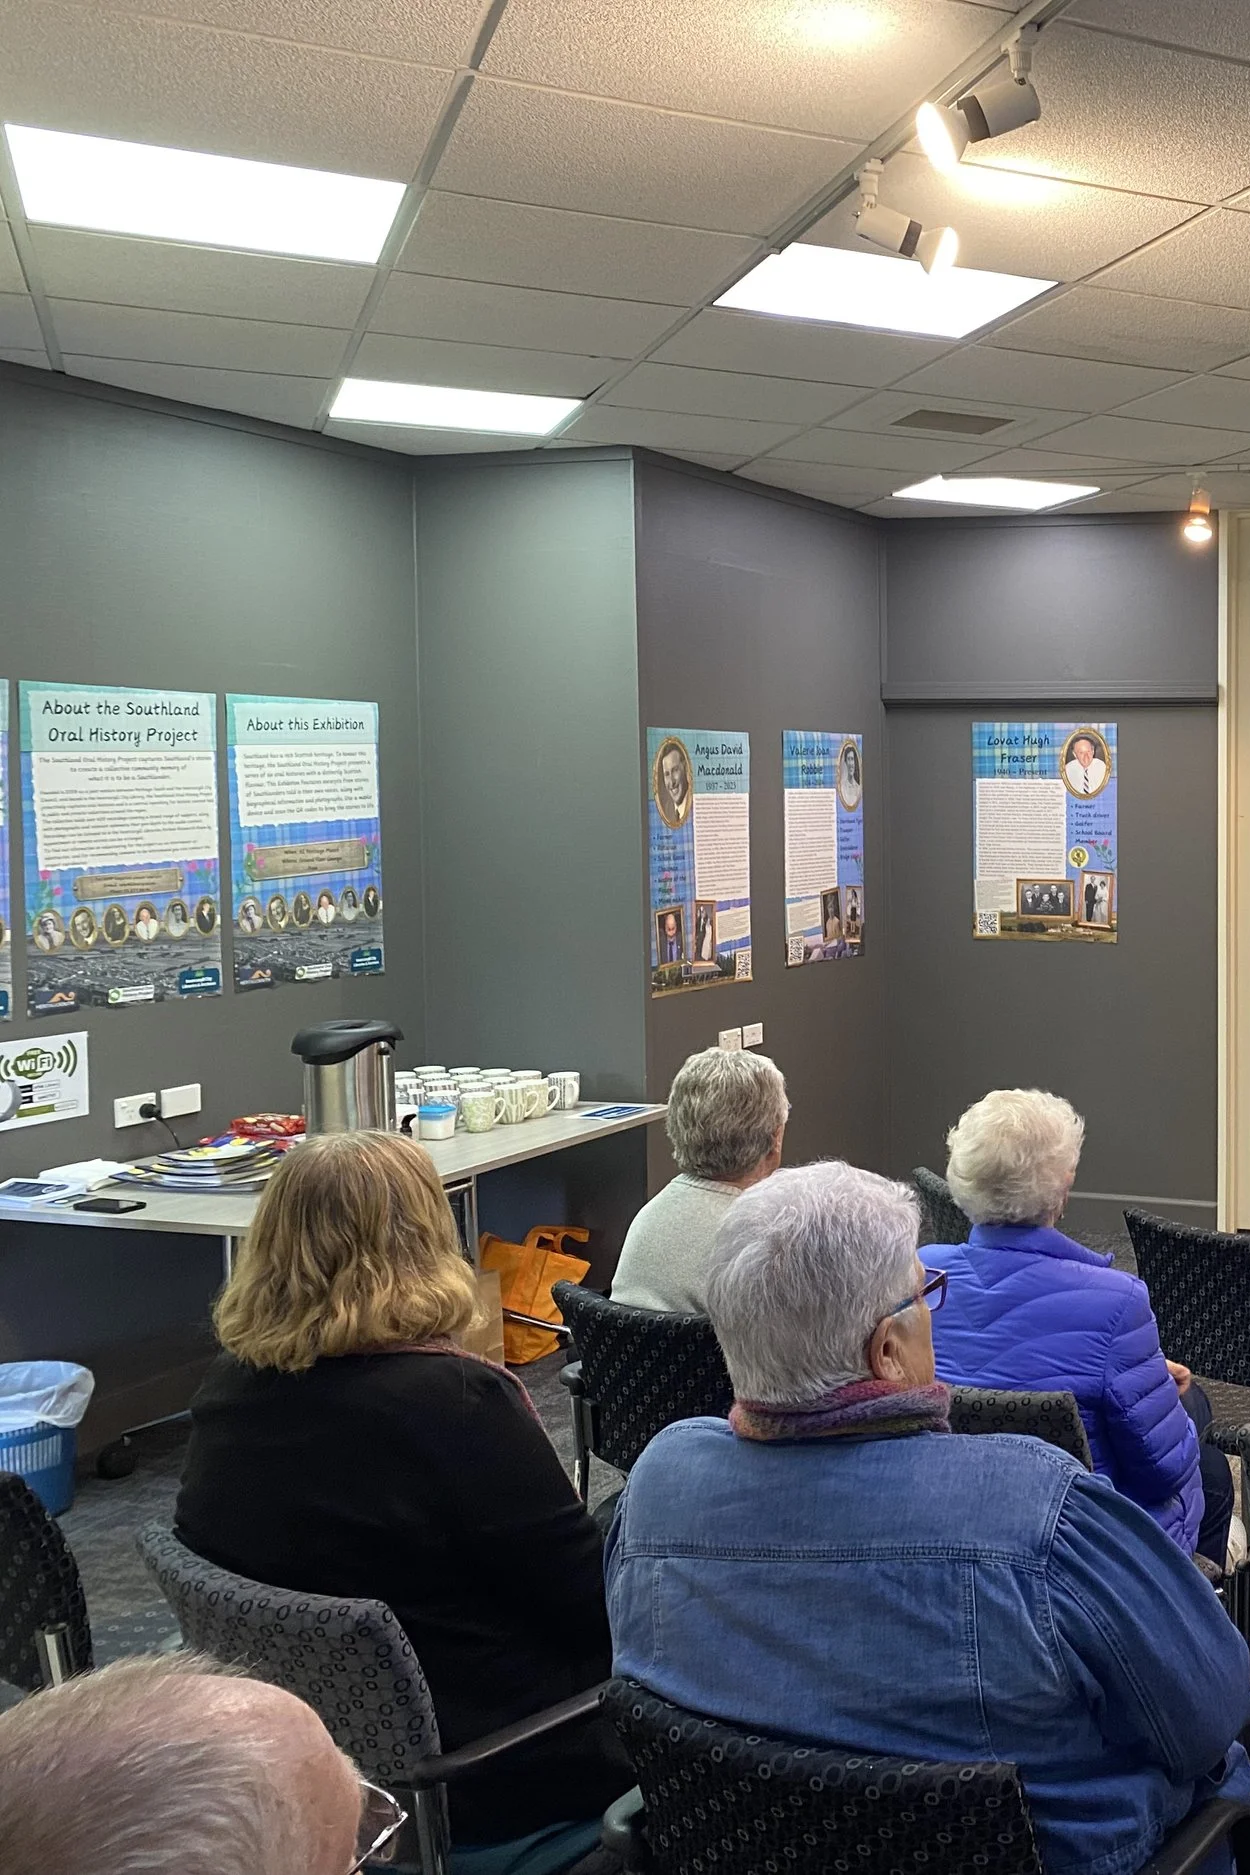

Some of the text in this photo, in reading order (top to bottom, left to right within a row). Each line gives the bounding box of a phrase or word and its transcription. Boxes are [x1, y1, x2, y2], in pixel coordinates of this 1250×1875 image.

[42, 699, 199, 716] About the Southland
[247, 717, 364, 731] About this Exhibition
[48, 727, 198, 747] Oral History Project
[988, 735, 1049, 748] Lovat Hugh
[695, 744, 743, 759] Angus David
[1001, 754, 1037, 763] Fraser
[697, 765, 743, 776] Macdonald
